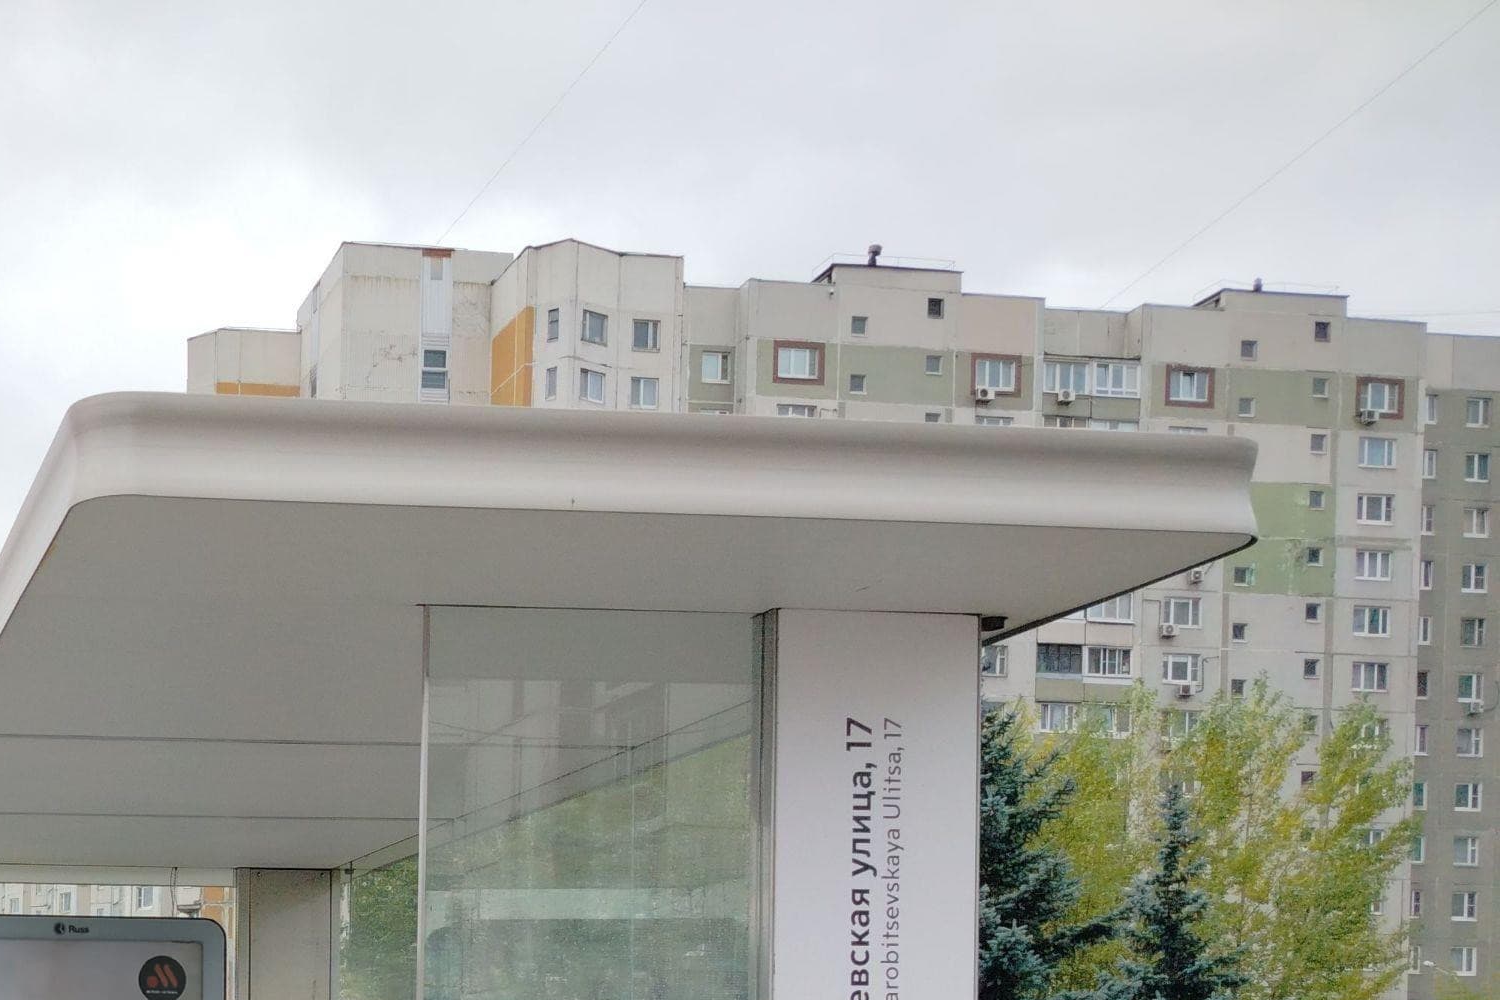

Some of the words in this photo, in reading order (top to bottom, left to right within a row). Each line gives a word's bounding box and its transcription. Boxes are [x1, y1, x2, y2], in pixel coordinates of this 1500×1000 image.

[846, 716, 873, 751] 17
[884, 716, 902, 742] 17
[882, 745, 906, 819] Ulitsa,
[851, 762, 878, 878] улица,
